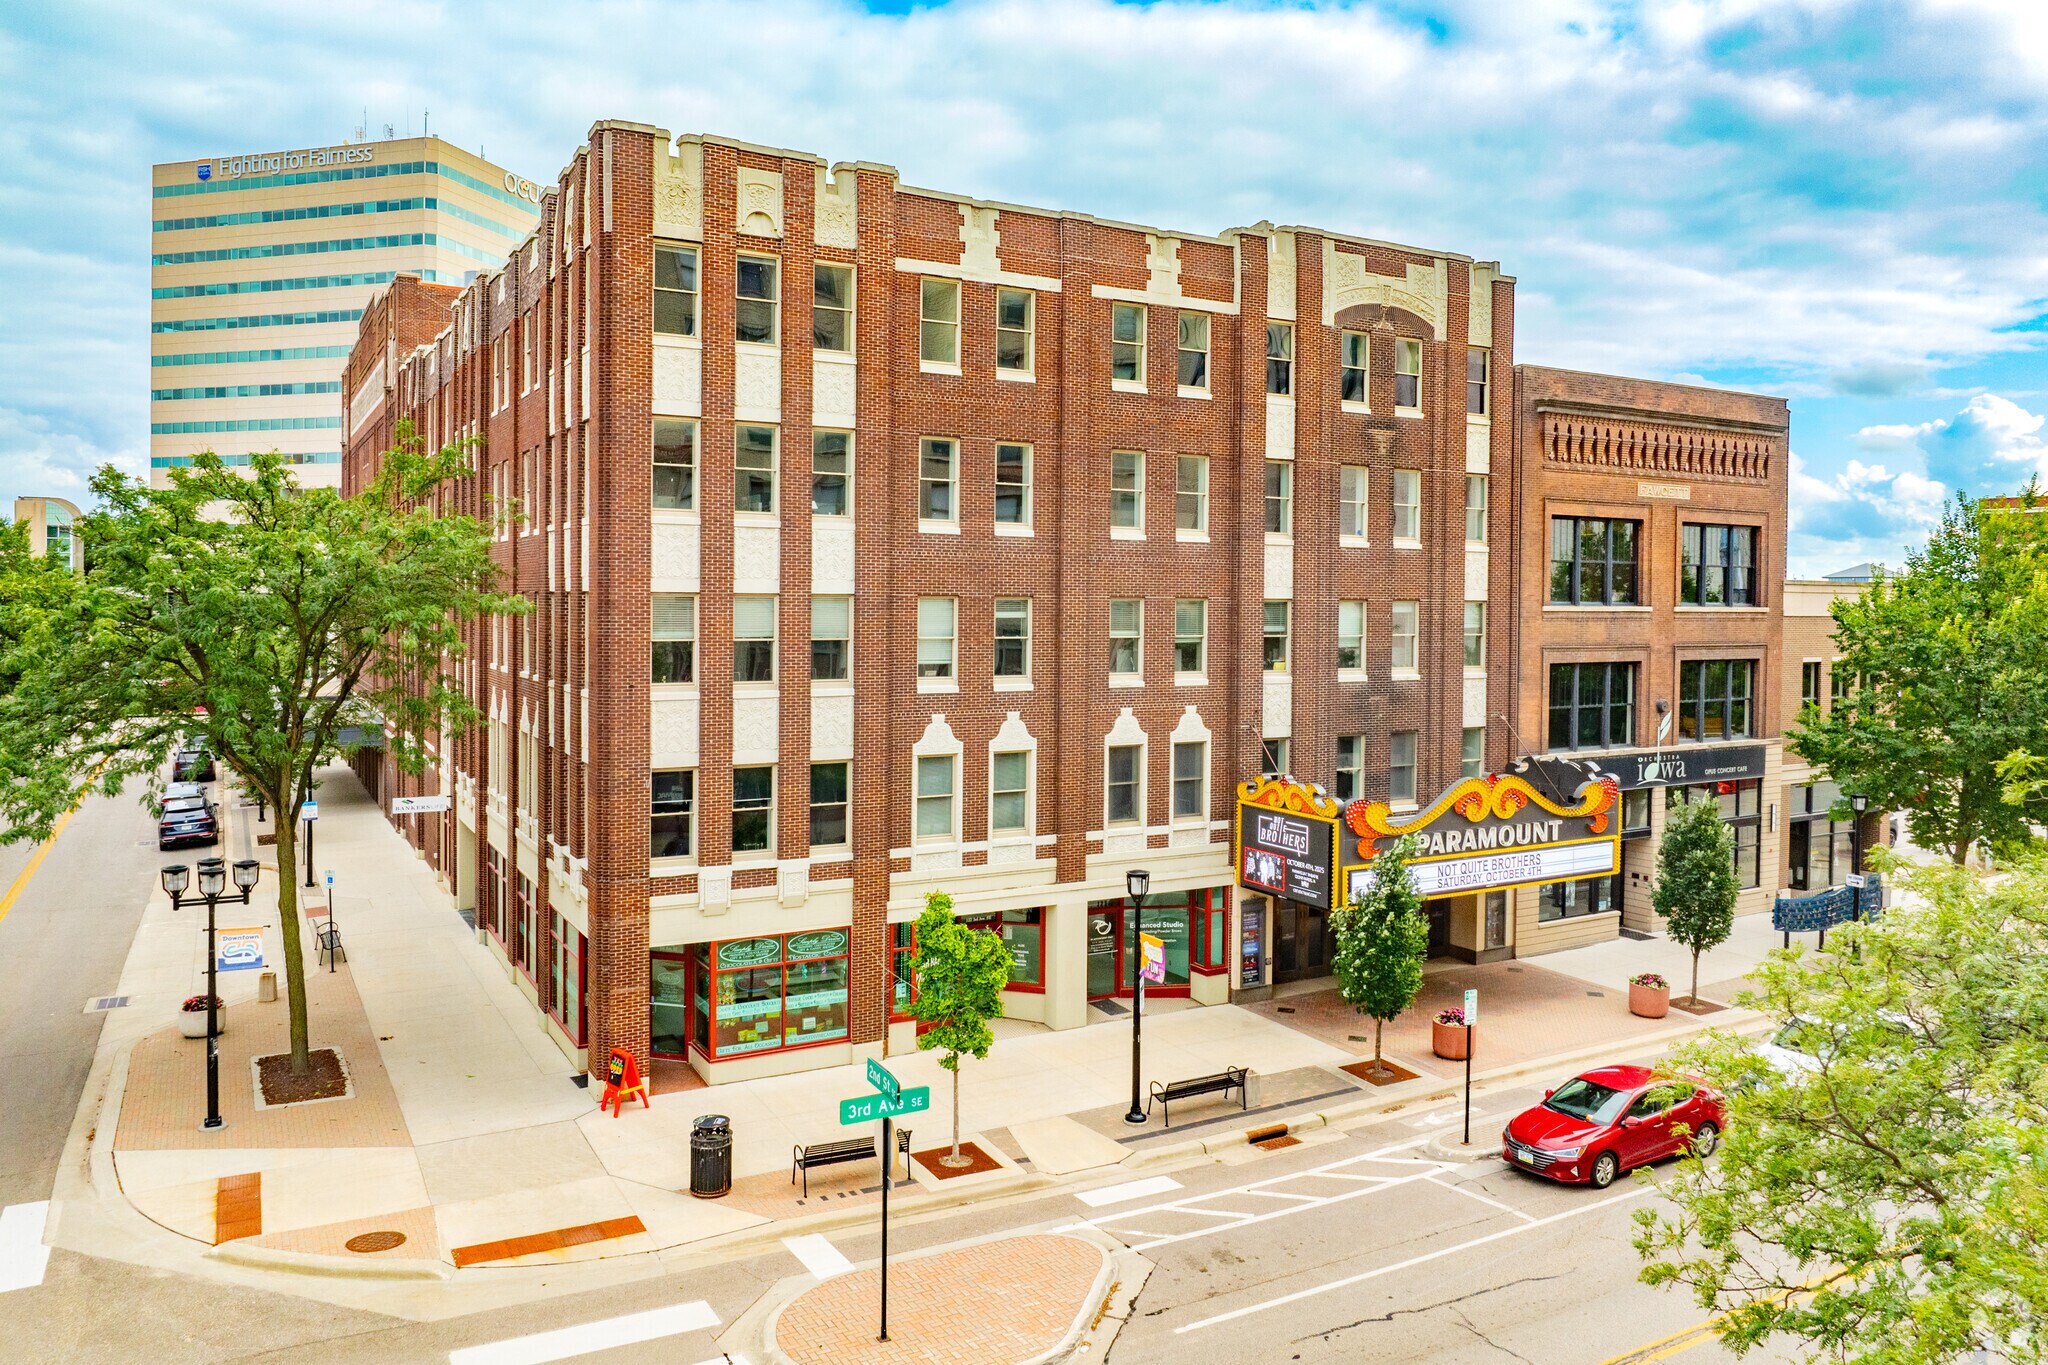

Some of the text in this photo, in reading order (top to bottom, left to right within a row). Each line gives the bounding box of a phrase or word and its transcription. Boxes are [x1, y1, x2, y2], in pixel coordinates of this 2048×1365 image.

[220, 147, 373, 178] Fighting for Fairness
[1415, 820, 1563, 856] PARAMOUNT
[1437, 853, 1542, 878] NOT QUITE BROTHERS
[1486, 868, 1526, 882] OCTOBER
[1527, 866, 1542, 876] 4TH
[1162, 920, 1184, 929] Studio
[868, 1064, 880, 1085] 2nd
[882, 1076, 891, 1093] St
[847, 1096, 923, 1119] 3rd Ave SE
